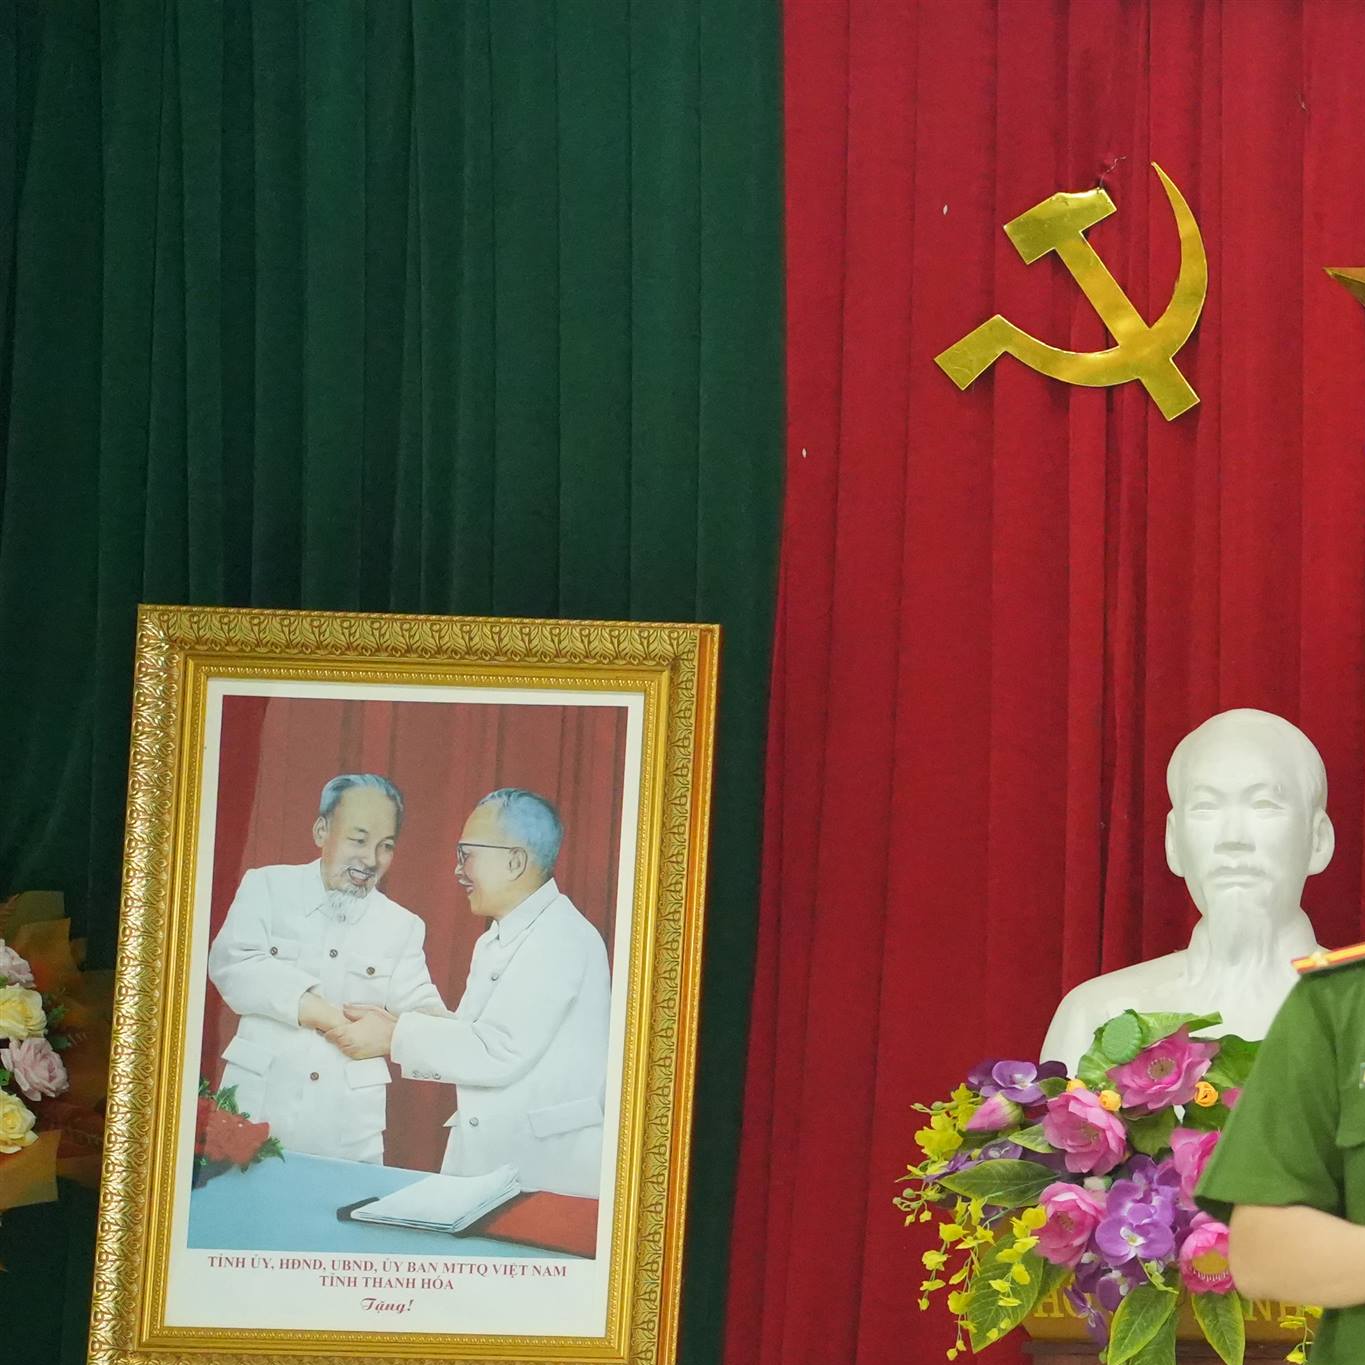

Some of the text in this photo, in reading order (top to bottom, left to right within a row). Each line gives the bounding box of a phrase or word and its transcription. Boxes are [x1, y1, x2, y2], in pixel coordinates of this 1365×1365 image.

[208, 1253, 246, 1268] TỈNH
[279, 1257, 327, 1271] HĐND,
[331, 1259, 378, 1273] UBND,
[382, 1258, 404, 1273] ỦY
[407, 1261, 439, 1274] BAN
[442, 1262, 488, 1277] MTTQ
[492, 1262, 529, 1278] VIỆT
[531, 1264, 568, 1277] NAM
[319, 1273, 455, 1290] TỈNH THANH HÓA
